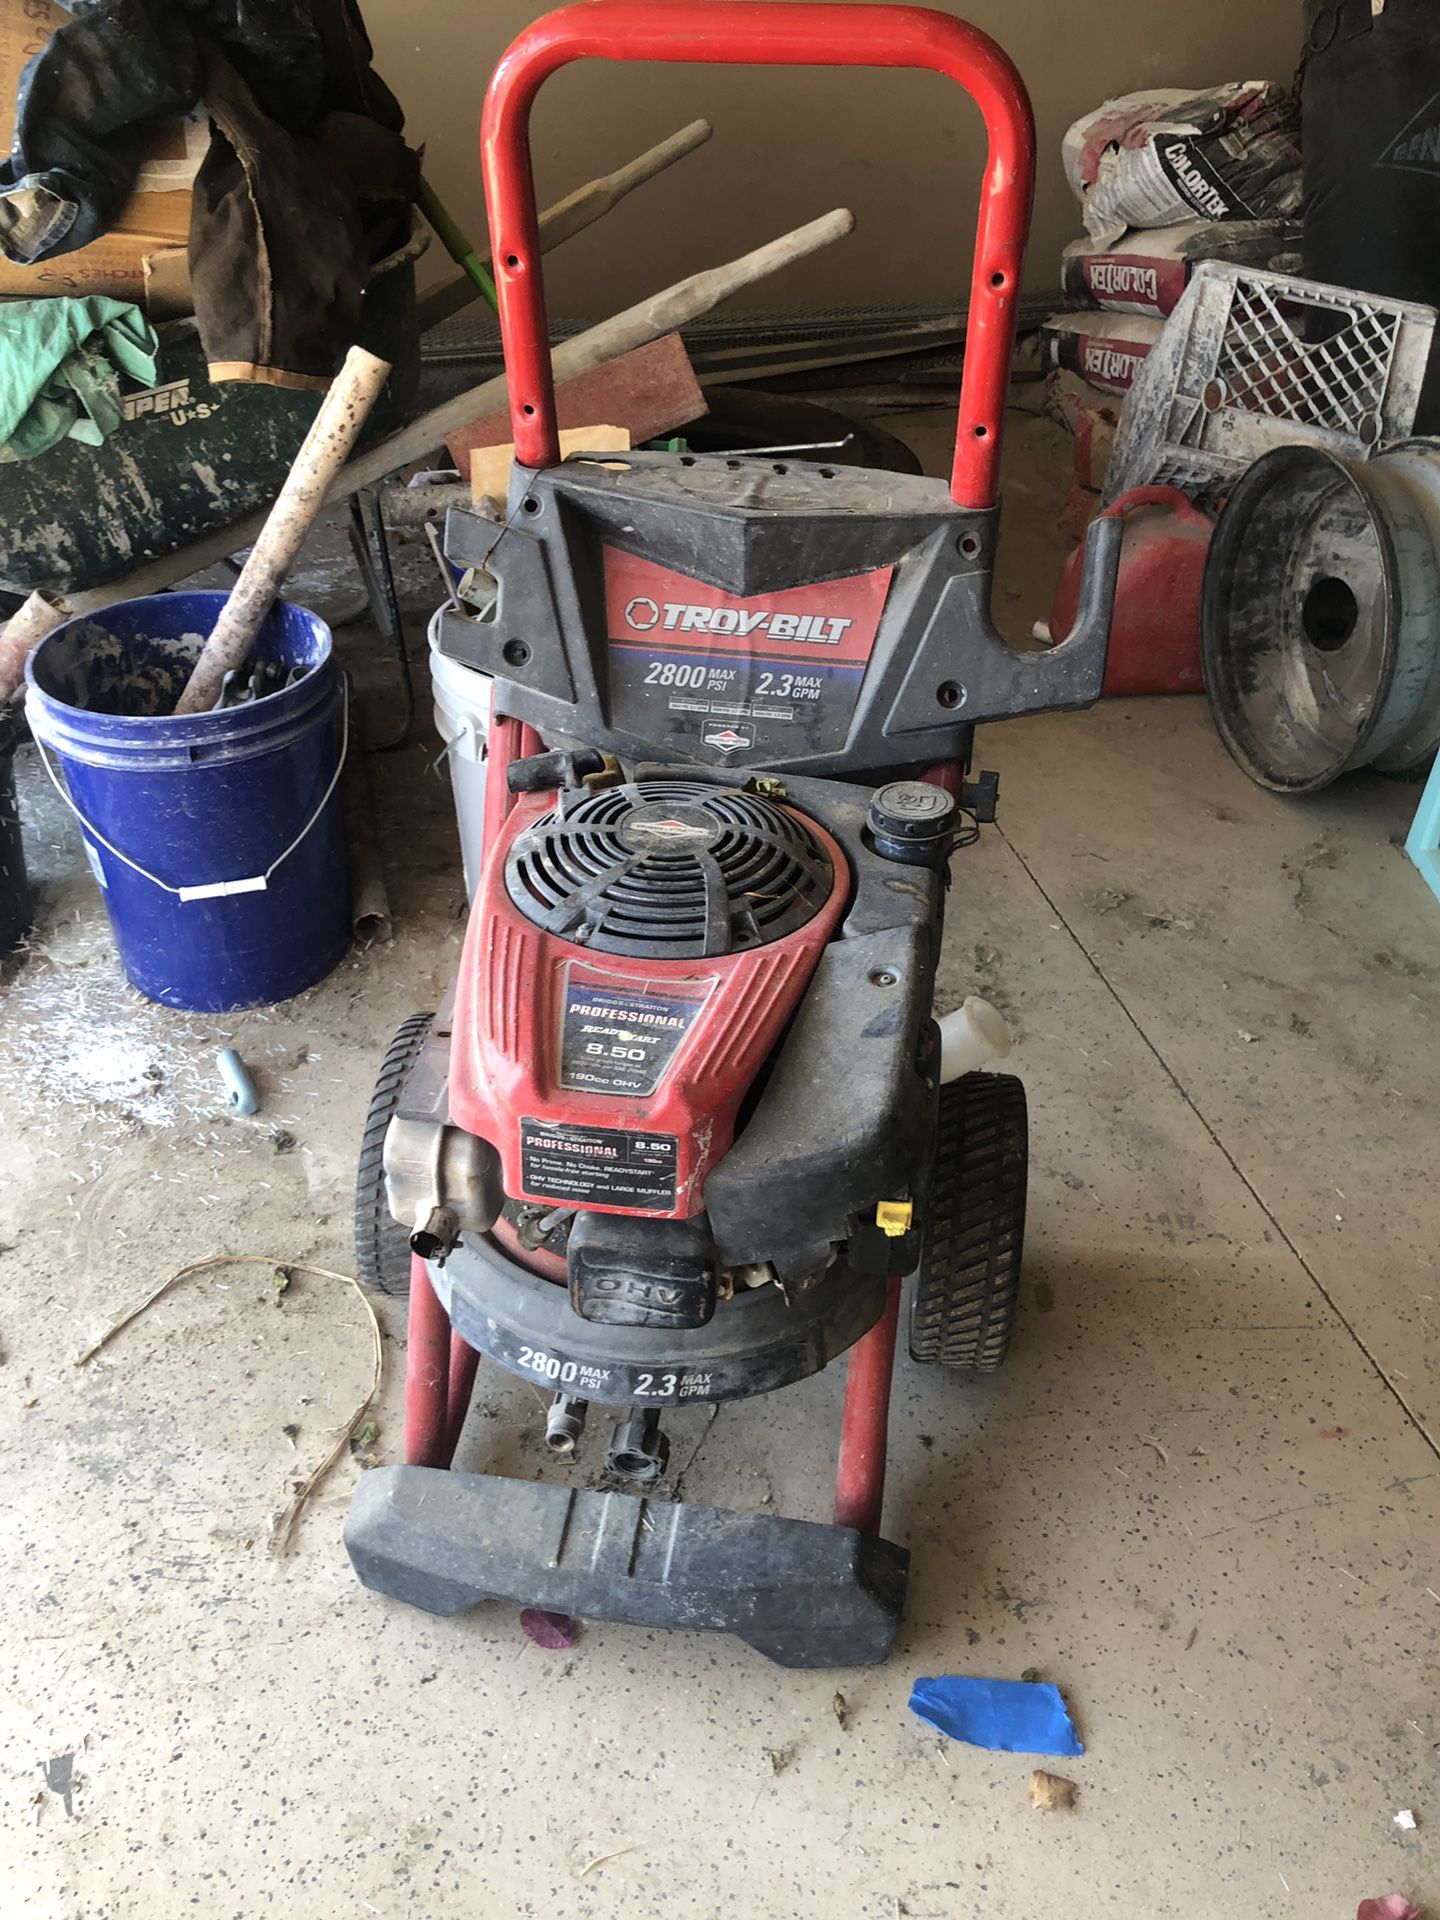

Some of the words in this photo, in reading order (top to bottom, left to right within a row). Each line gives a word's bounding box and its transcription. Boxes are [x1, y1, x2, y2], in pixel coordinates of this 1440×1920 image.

[1165, 143, 1229, 215] COLORTEK
[1090, 264, 1158, 300] COLORTEK
[1085, 347, 1145, 379] LORTEK
[662, 603, 853, 645] TROY-BILT
[644, 662, 706, 689] 2800
[708, 668, 736, 681] MAX
[707, 680, 727, 691] PSI
[755, 672, 794, 697] 2.3
[794, 676, 823, 688] MAX
[792, 687, 821, 700] GPM
[569, 1004, 686, 1029] PROFESSIONAL
[585, 1042, 646, 1061] 8.50
[569, 1072, 609, 1084] 190cc
[613, 1079, 641, 1088] OHV
[526, 1136, 619, 1157] PROFESSIONAL
[635, 1141, 671, 1151] 8.50
[581, 1170, 610, 1179] starting
[542, 1182, 571, 1191] reduced
[547, 1177, 595, 1188] TECHNOLOGY
[611, 1185, 635, 1193] LARGE
[636, 1187, 672, 1196] MUFFLER
[596, 1278, 684, 1304] OHV
[517, 1346, 578, 1383] 2800
[579, 1365, 611, 1381] MAX
[579, 1377, 601, 1390] PSI
[633, 1373, 678, 1397] 2.3
[680, 1373, 713, 1385] MAX
[679, 1385, 711, 1397] GPM
